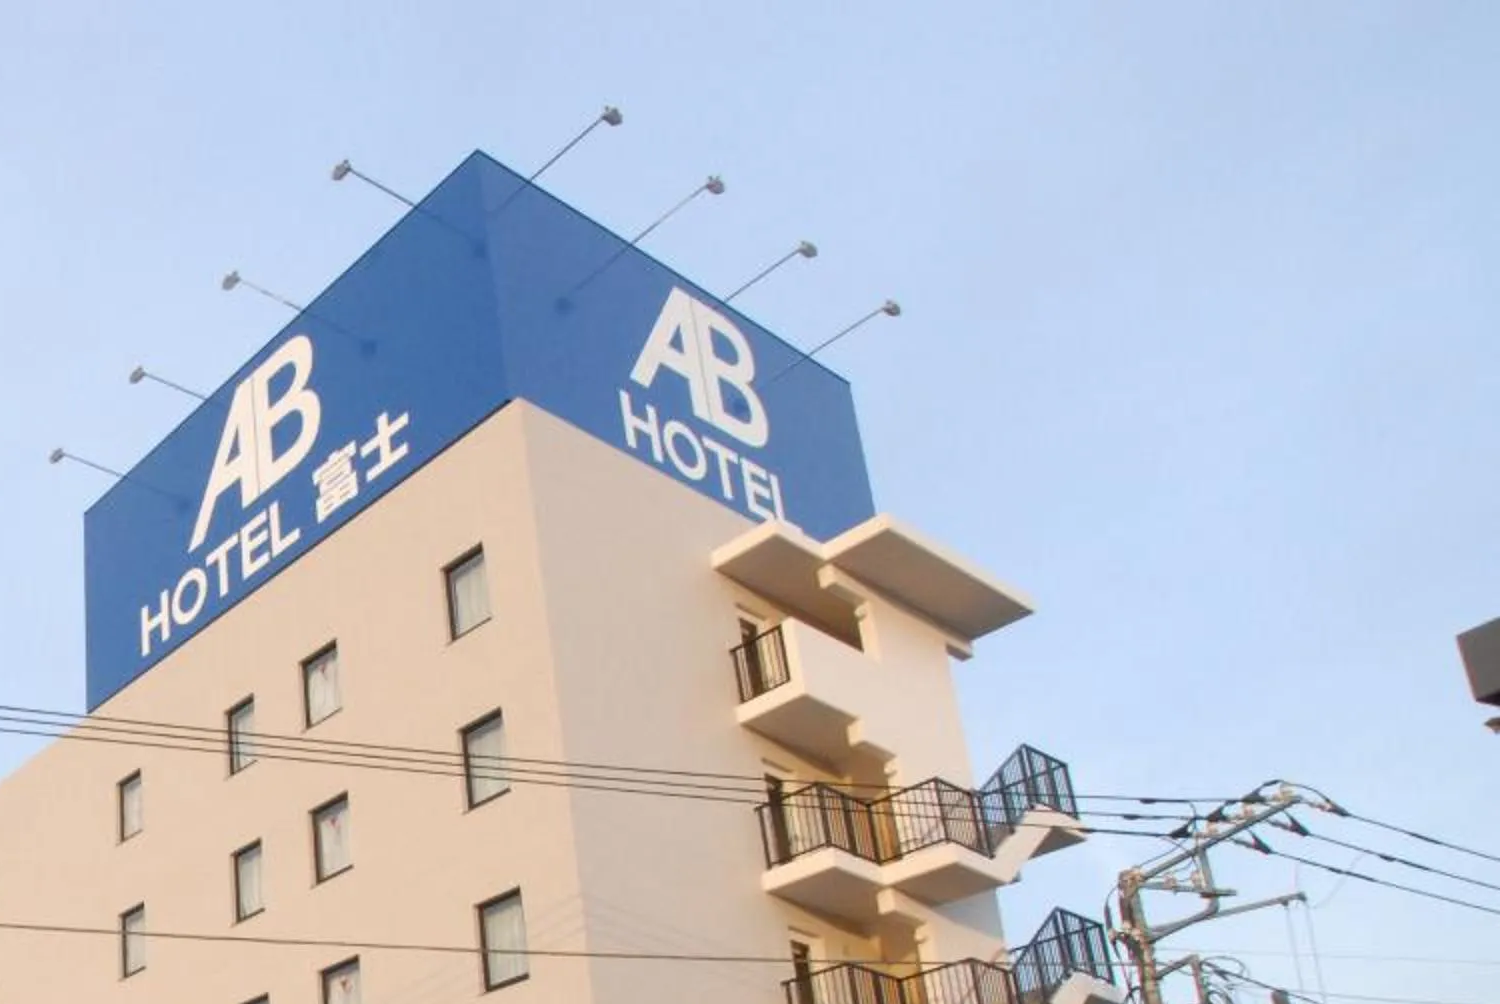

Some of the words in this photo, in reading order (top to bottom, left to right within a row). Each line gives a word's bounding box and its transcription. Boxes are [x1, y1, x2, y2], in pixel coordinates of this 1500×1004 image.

[188, 335, 321, 553] AB
[630, 286, 768, 447] AB
[140, 501, 301, 657] HOTEL
[311, 412, 409, 523] 富士
[619, 389, 803, 534] HOTEL
